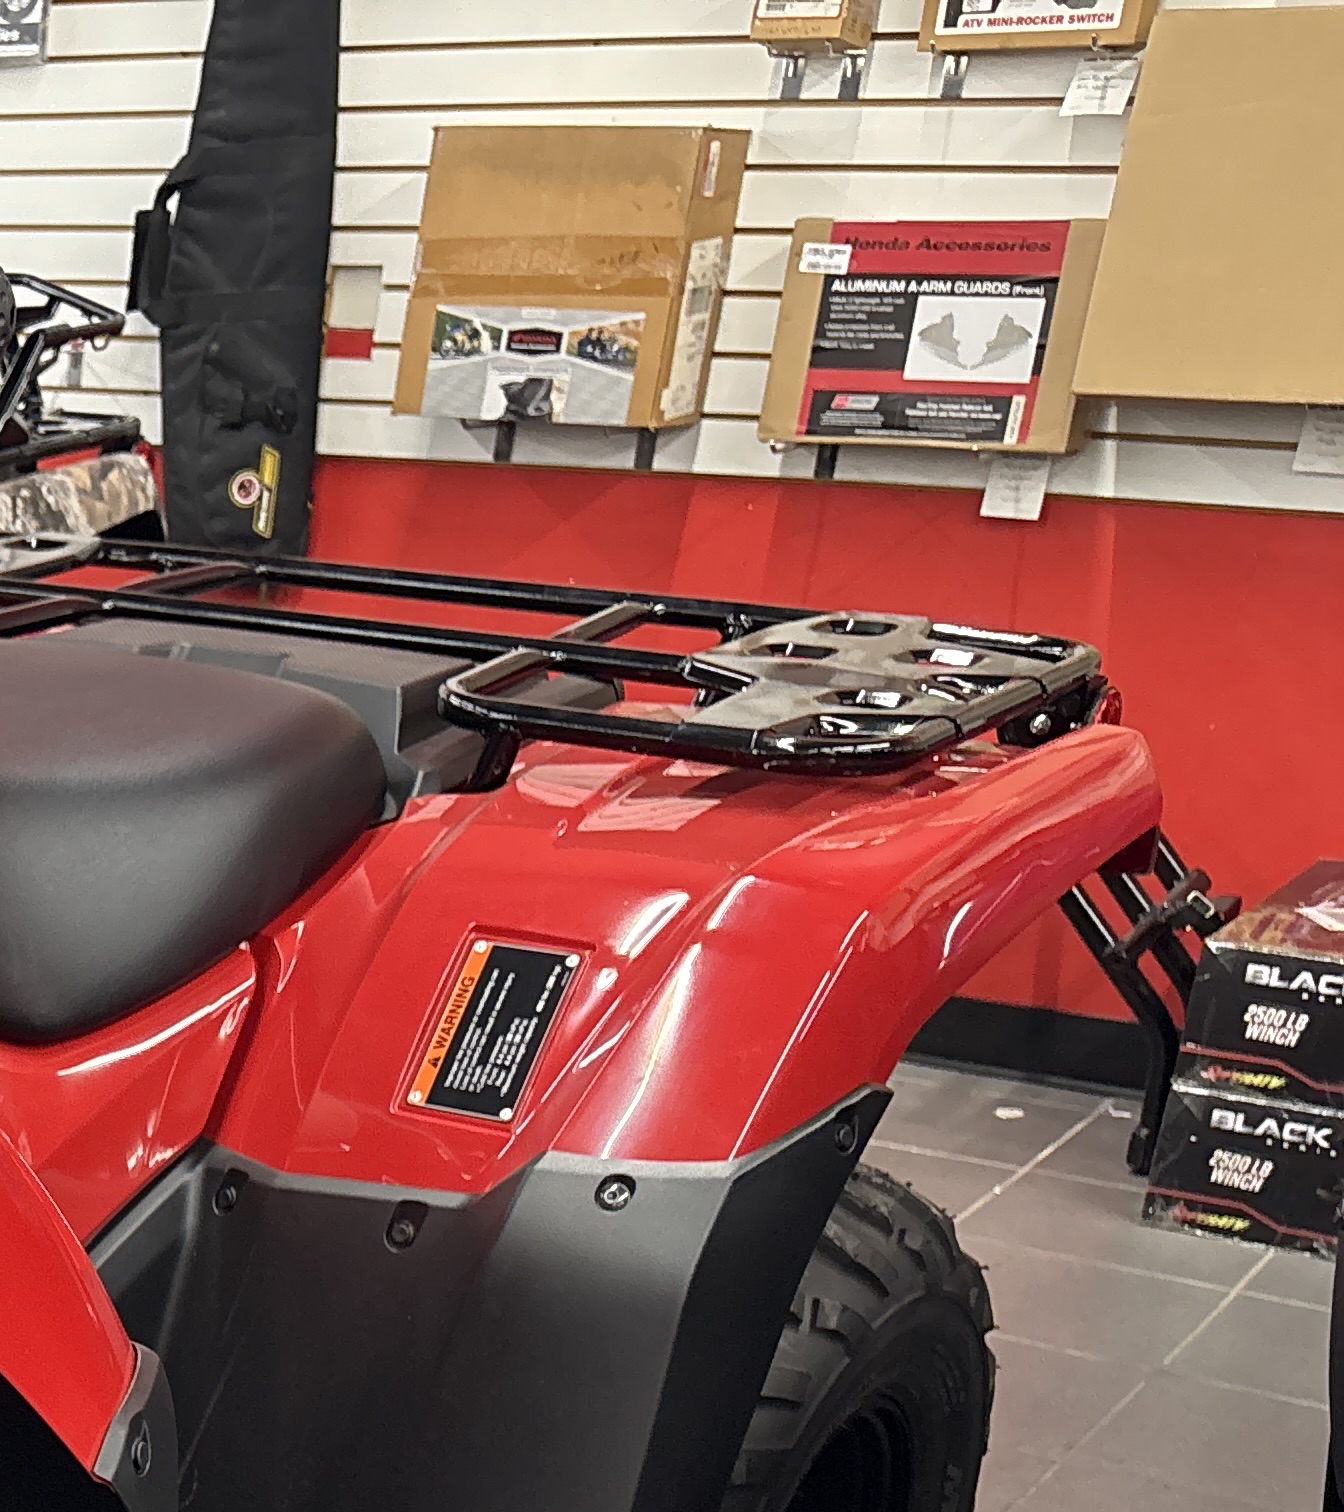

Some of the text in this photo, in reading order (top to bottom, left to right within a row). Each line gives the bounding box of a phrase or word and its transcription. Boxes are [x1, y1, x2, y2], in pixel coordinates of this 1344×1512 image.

[962, 12, 1115, 29] ATV MINI-ROCKER SWITCH
[915, 235, 1052, 253] Accessories
[830, 278, 907, 294] ALUMINUM
[953, 280, 1011, 295] GUARDS
[1244, 962, 1344, 995] BLAC
[432, 975, 476, 1052] WARNING
[1243, 1003, 1286, 1027] 2500
[1244, 1023, 1301, 1048] WINCH
[1209, 1107, 1334, 1149] BLACK
[1208, 1148, 1252, 1174] 2500
[1210, 1167, 1265, 1194] WINCH
